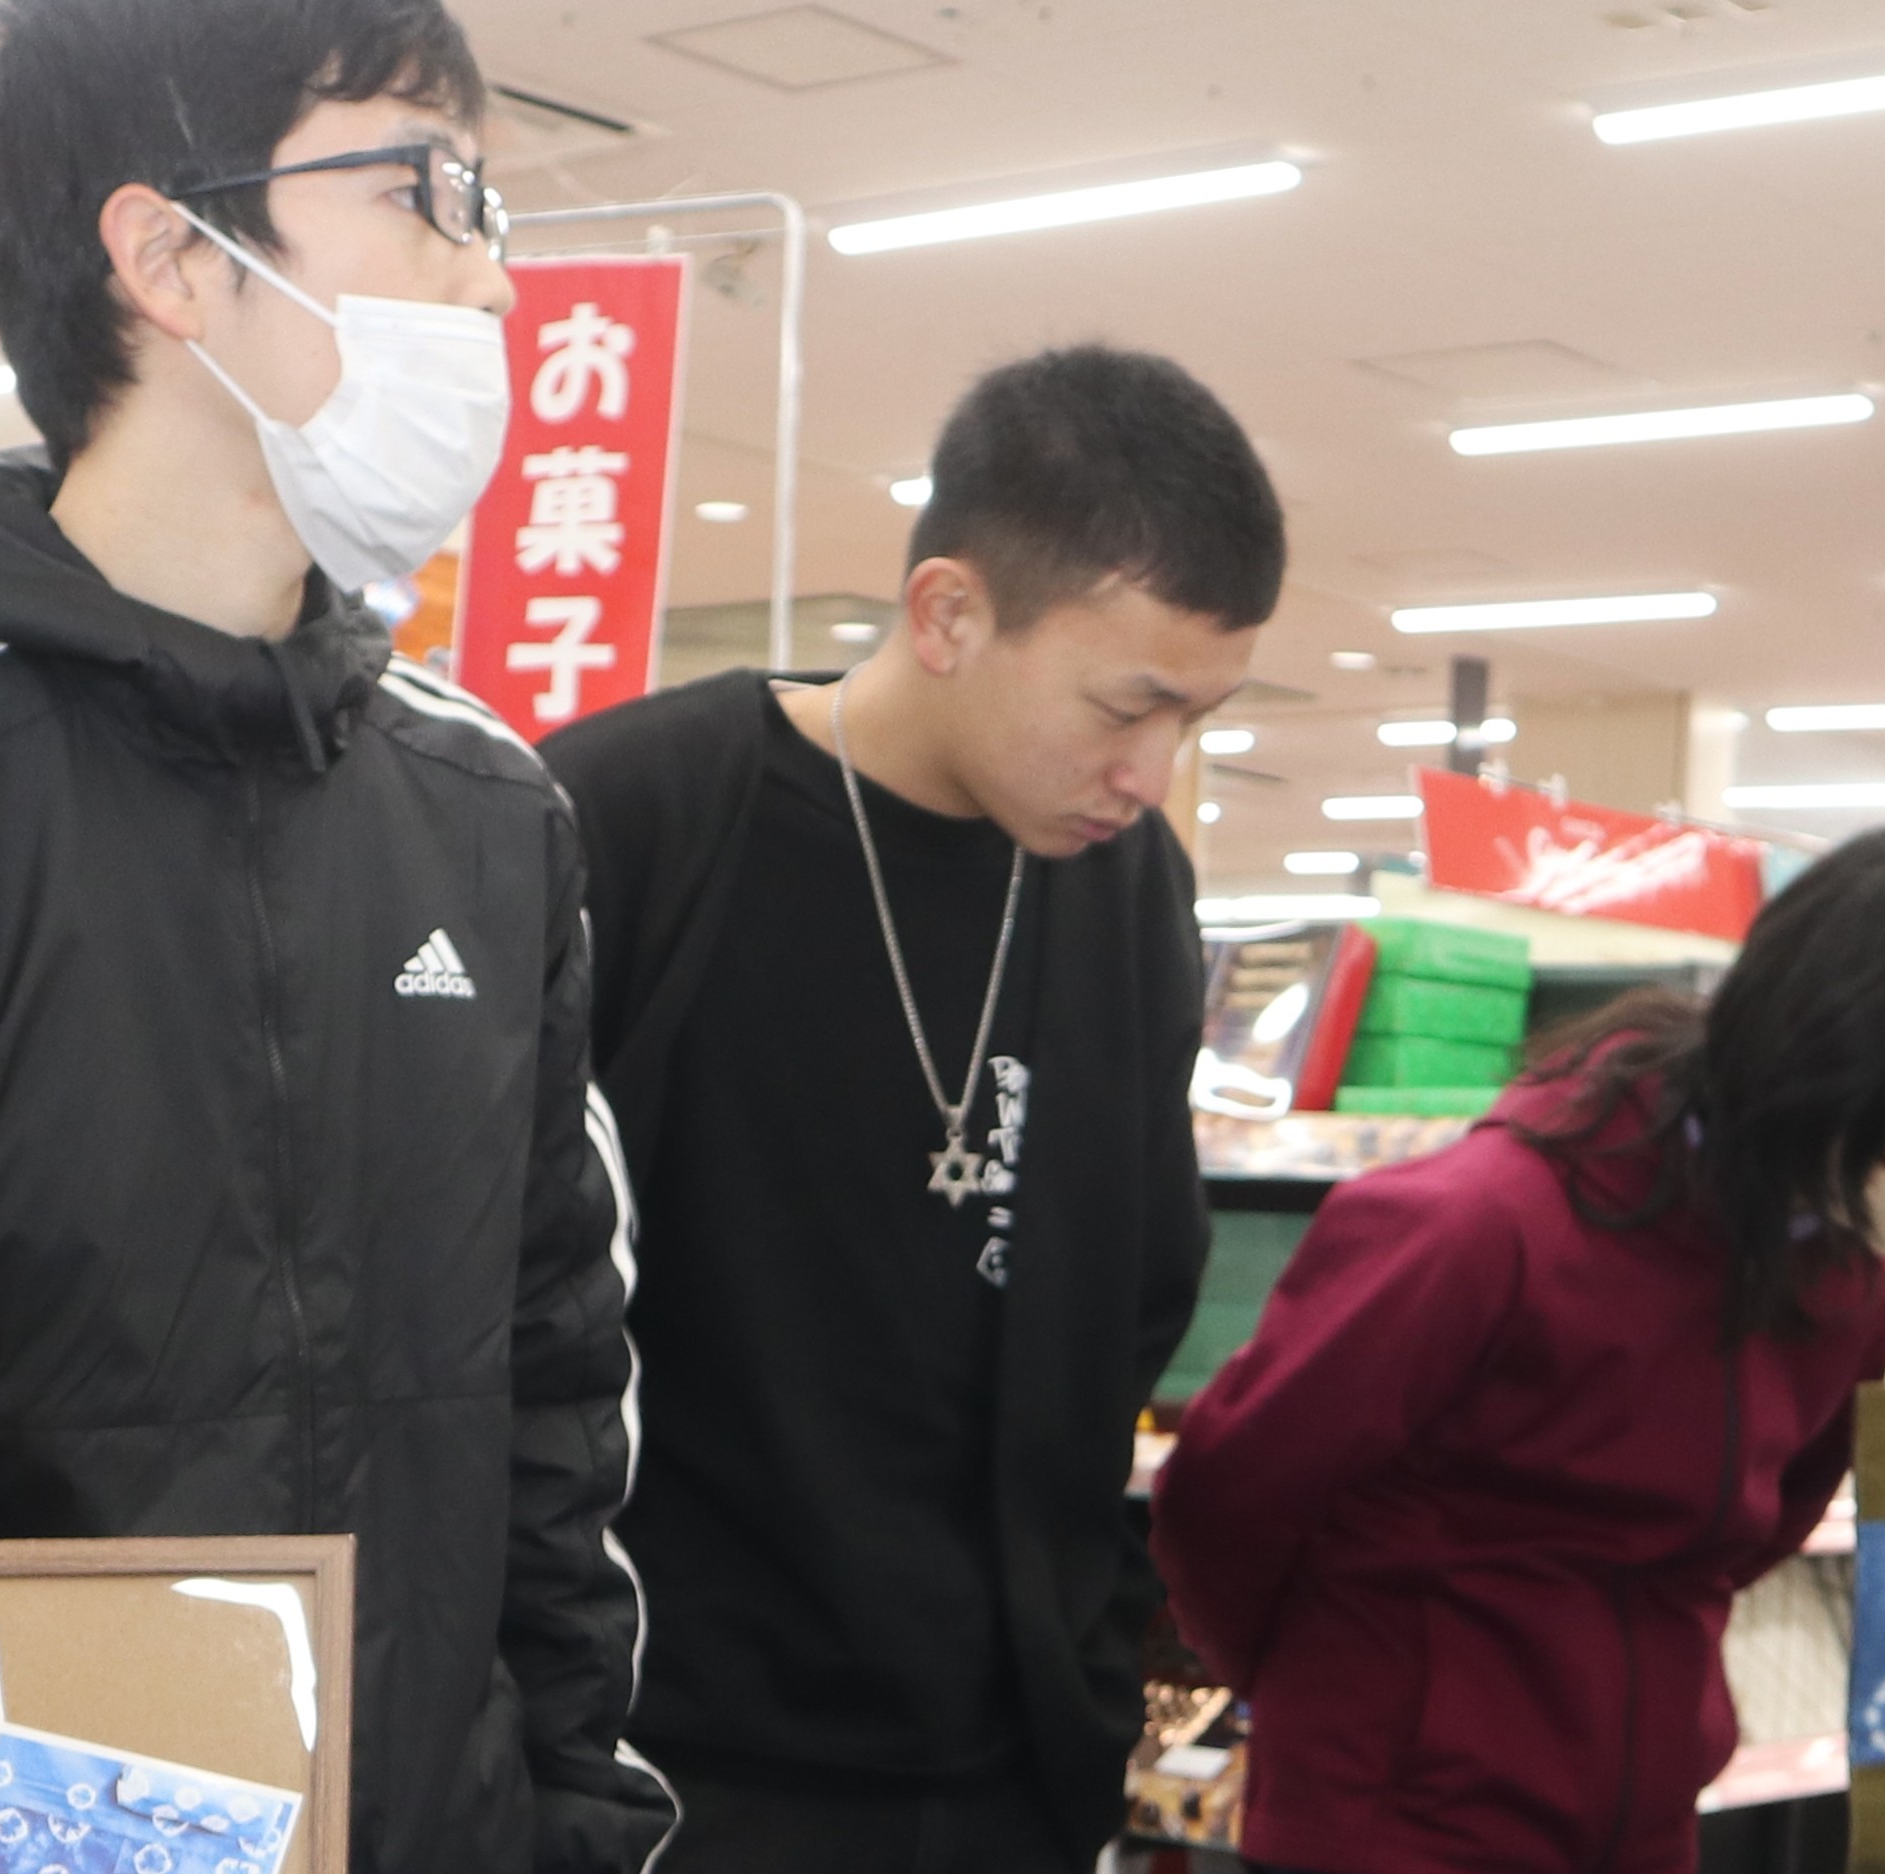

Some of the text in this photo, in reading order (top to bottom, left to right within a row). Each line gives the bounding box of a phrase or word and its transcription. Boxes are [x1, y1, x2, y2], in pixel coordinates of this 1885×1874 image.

[505, 301, 636, 722] お菓子
[394, 972, 476, 1000] adidas
